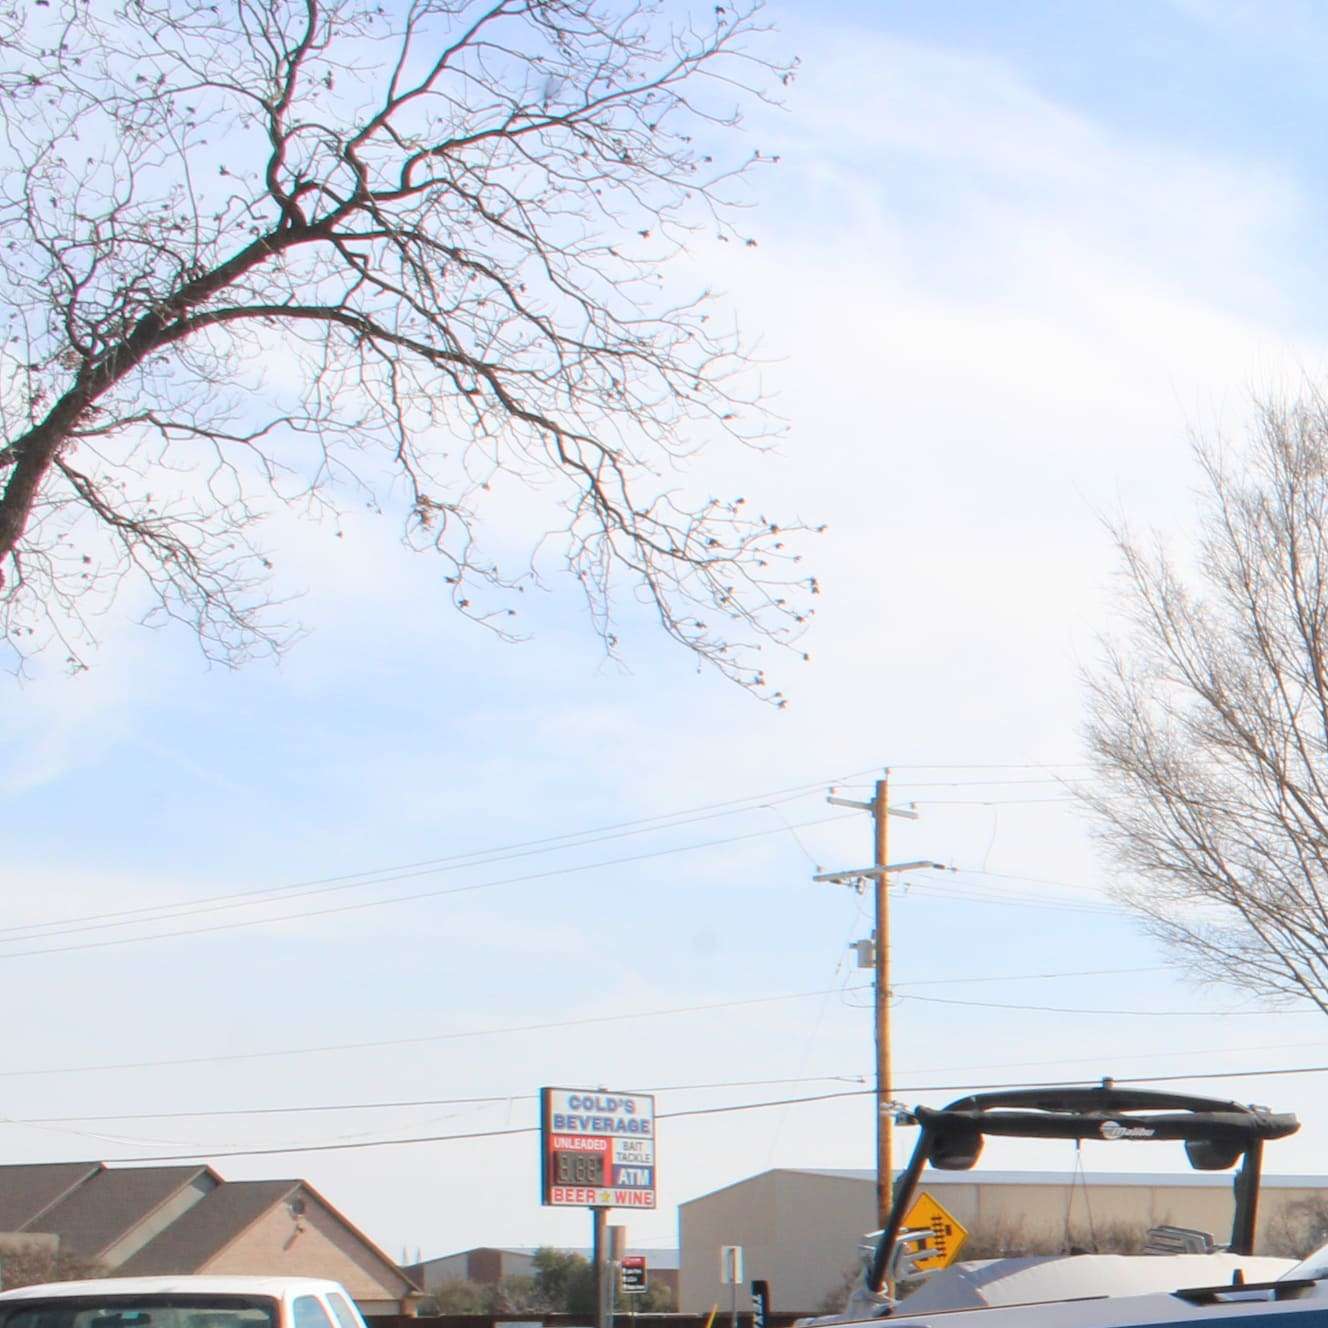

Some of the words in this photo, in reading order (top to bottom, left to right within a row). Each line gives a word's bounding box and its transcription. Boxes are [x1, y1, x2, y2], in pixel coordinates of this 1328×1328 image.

[569, 1095, 636, 1114] COLD'S
[553, 1115, 650, 1134] BEVERAGE
[553, 1138, 607, 1151] UNLEADED
[623, 1141, 643, 1151] BAIT
[616, 1152, 652, 1163] TACKLE
[619, 1168, 650, 1185] ATM
[553, 1188, 597, 1203] BEER
[615, 1191, 653, 1205] WINE
